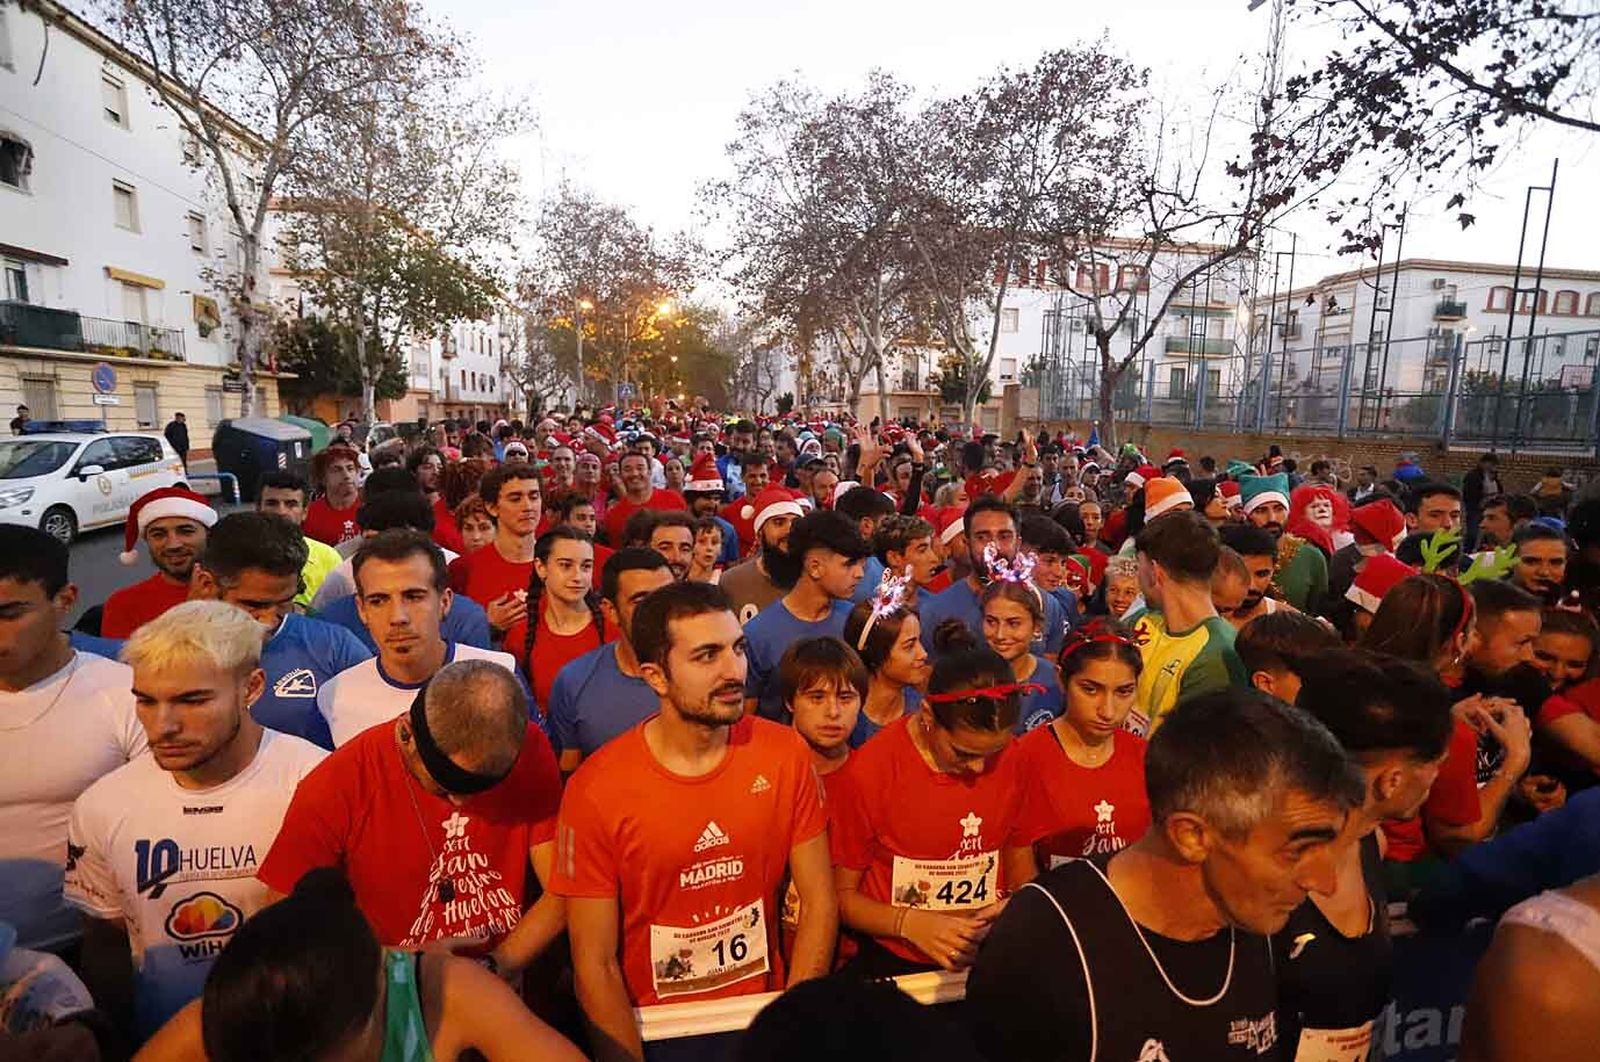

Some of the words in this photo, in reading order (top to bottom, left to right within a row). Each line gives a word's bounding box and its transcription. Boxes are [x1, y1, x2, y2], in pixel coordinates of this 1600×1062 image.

[179, 845, 257, 871] HUELVA
[680, 860, 743, 888] MADRID
[936, 876, 988, 905] 424
[443, 887, 516, 926] Huelva
[712, 933, 747, 967] 16
